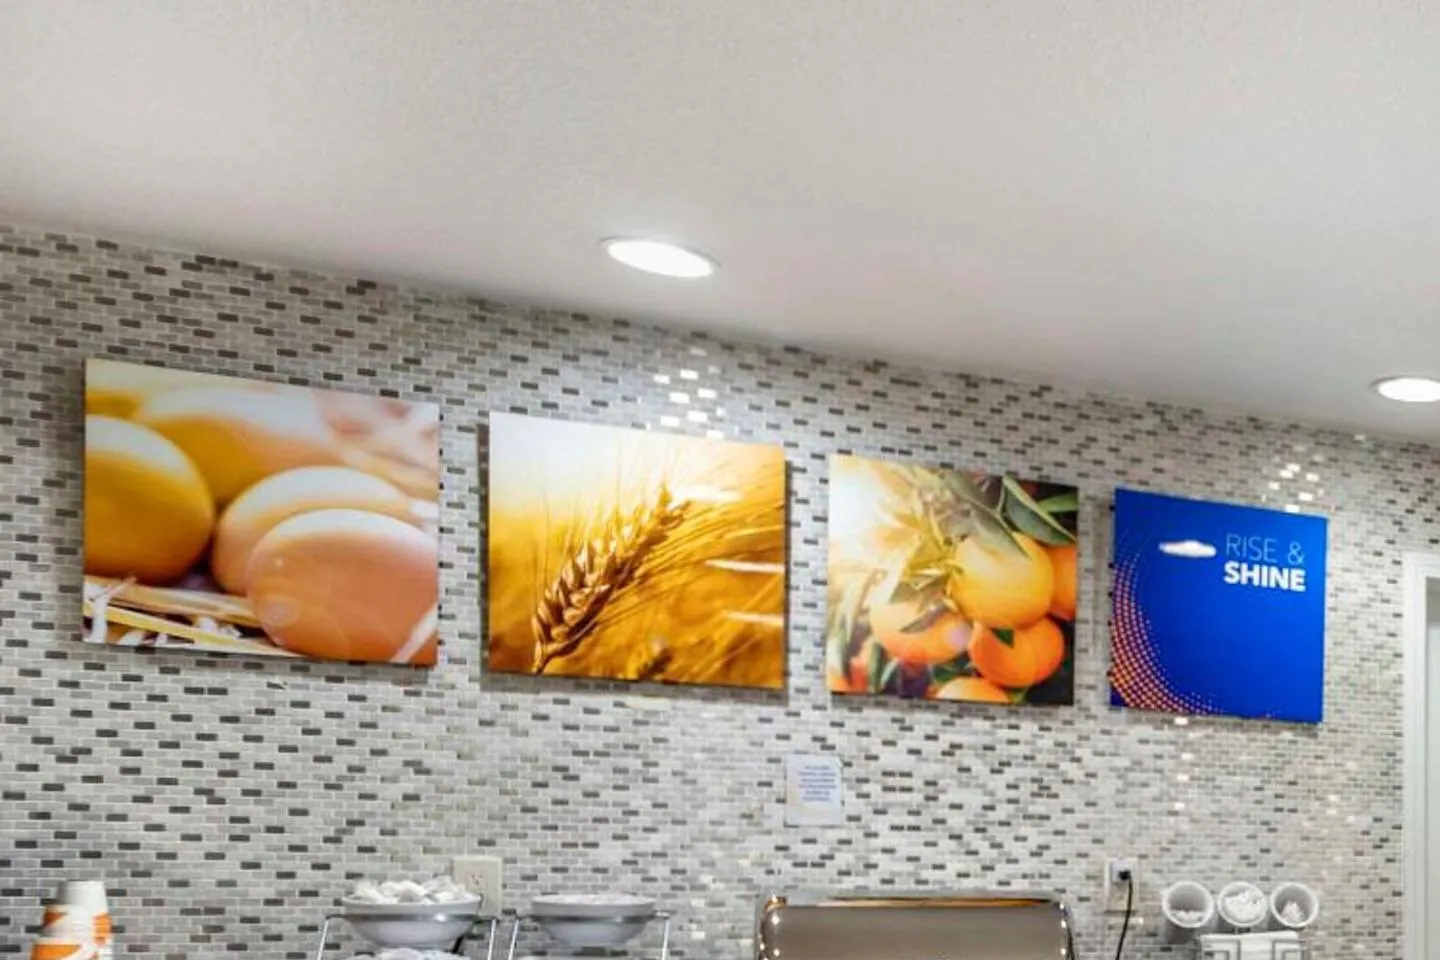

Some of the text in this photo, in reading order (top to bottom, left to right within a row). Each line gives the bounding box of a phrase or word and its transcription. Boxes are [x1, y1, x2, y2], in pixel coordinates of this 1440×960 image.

[1225, 532, 1305, 565] RISE &
[1224, 560, 1306, 592] SHINE
